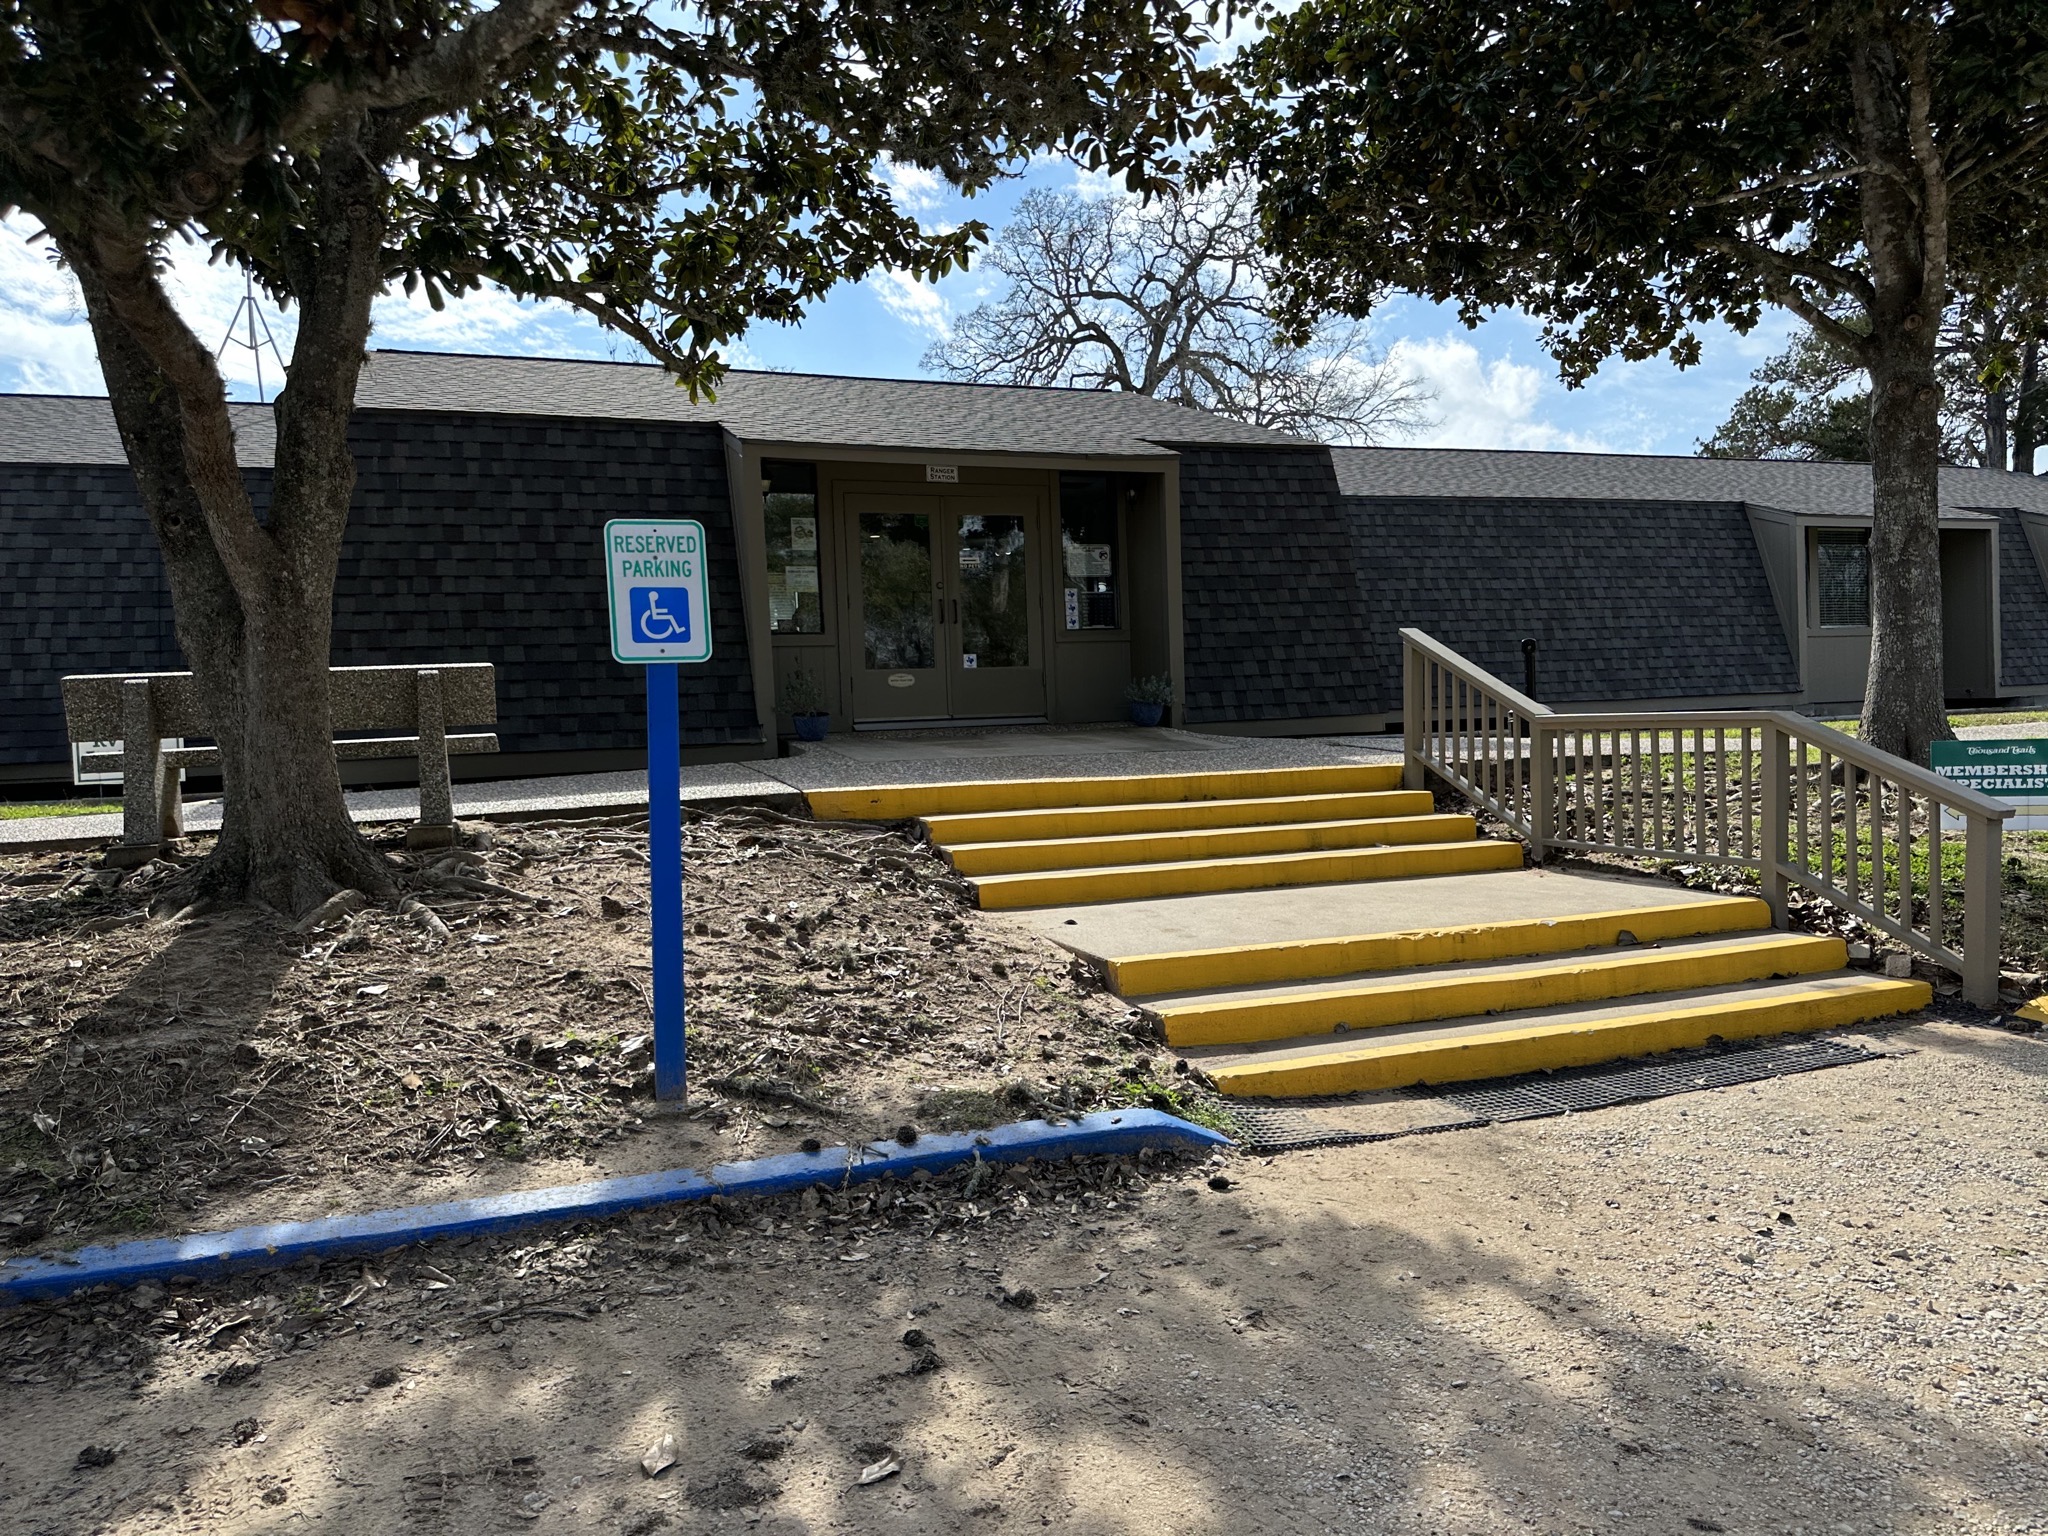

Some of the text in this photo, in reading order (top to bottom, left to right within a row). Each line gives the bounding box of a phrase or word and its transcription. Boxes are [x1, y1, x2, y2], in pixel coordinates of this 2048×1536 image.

[614, 535, 697, 553] RESERVED
[622, 560, 692, 578] PARKING
[1966, 745, 2036, 756] Thousand Trails
[1953, 778, 2048, 789] PECIALIS
